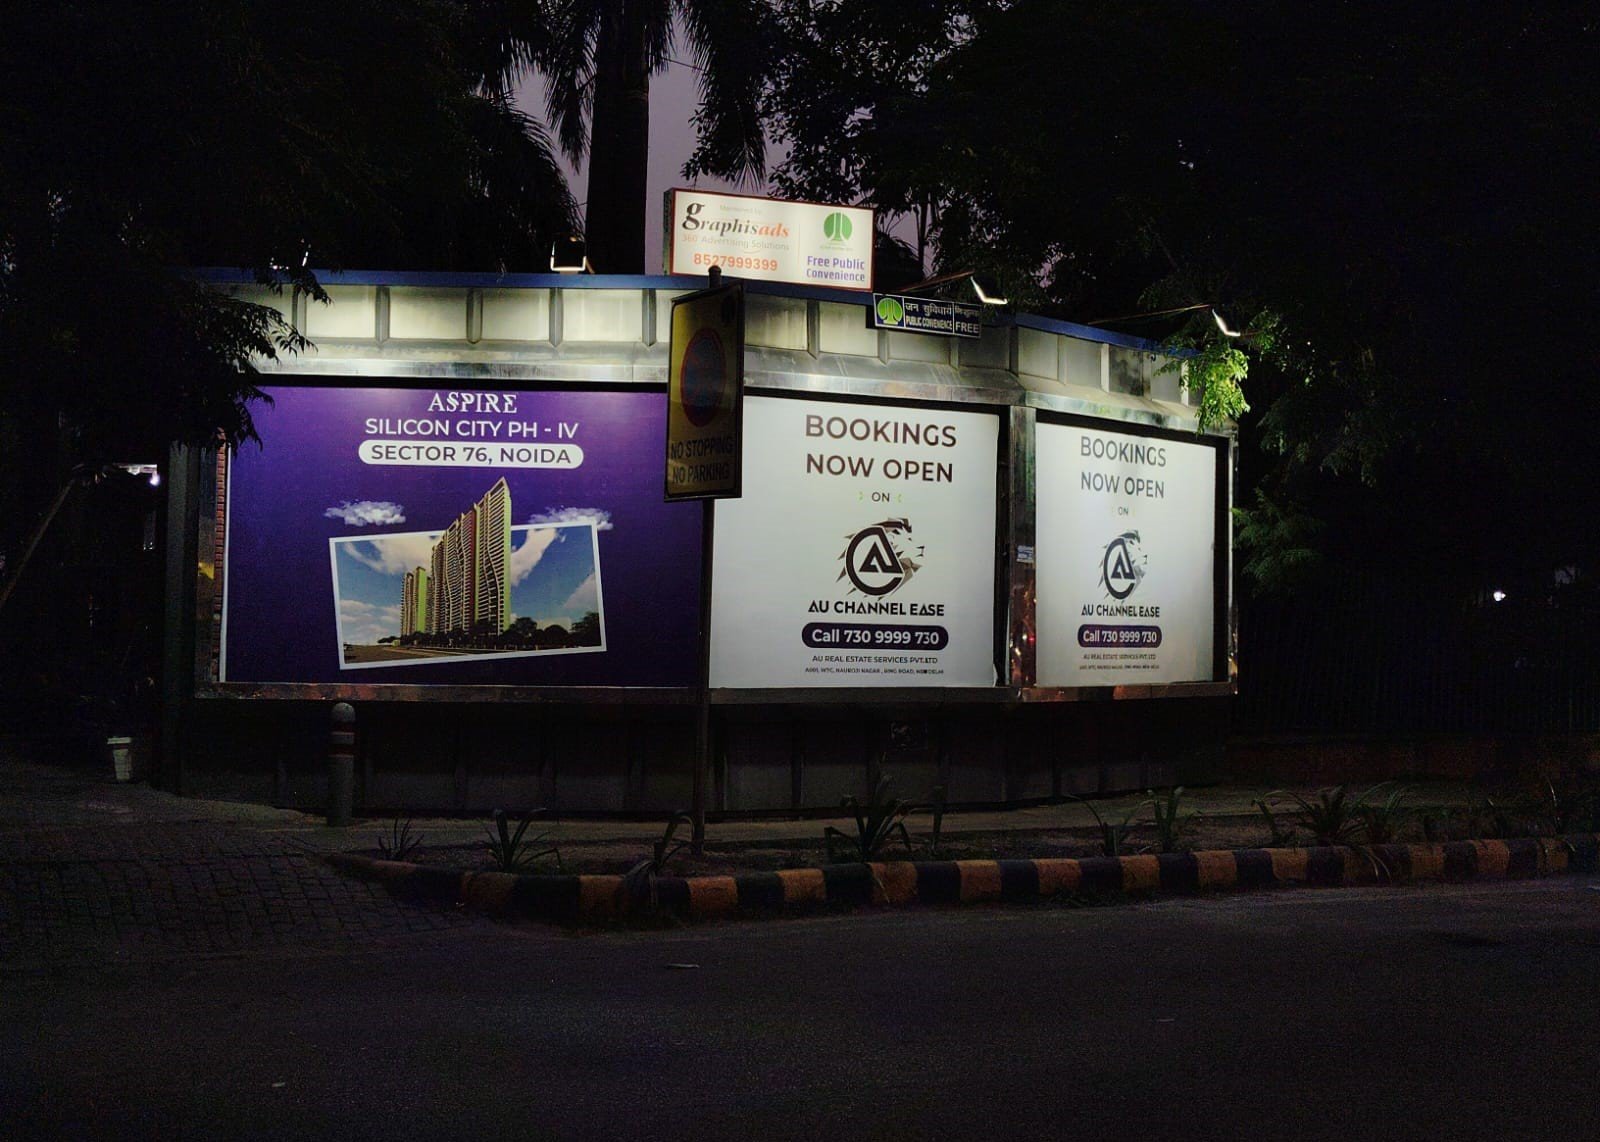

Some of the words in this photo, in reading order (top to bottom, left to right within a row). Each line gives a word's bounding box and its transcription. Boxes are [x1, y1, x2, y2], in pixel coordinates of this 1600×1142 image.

[682, 202, 789, 237] graphisads
[693, 253, 778, 272] 8527999399
[807, 255, 829, 268] Free
[832, 257, 865, 271] Public
[806, 268, 865, 282] Convenience
[905, 315, 922, 327] PUBLIC
[955, 320, 980, 334] FREE
[427, 391, 518, 414] ASPIRE
[365, 418, 450, 437] SILICON
[456, 420, 503, 438] CITY
[508, 422, 538, 439] PH
[558, 423, 579, 439] IV
[805, 414, 957, 448] BOOKINGS
[371, 444, 455, 462] SECTOR
[462, 445, 493, 465] 76,
[499, 447, 571, 465] NOIDA
[671, 441, 685, 459] NO
[686, 436, 734, 458] STOPPING
[1080, 436, 1166, 467] BOOKINGS
[672, 466, 686, 483] NO
[688, 463, 730, 483] PARKING
[806, 453, 874, 478] NOW
[883, 459, 953, 483] OPEN
[1081, 471, 1120, 495] NOW
[1124, 476, 1164, 499] OPEN
[871, 492, 890, 503] ON
[1117, 506, 1129, 516] ON
[808, 599, 829, 614] AU
[834, 600, 907, 616] CHANNEL
[910, 603, 945, 617] EASE
[1081, 604, 1094, 617] AU
[1096, 604, 1138, 618] CHANNEL
[1139, 606, 1160, 618] EASE
[812, 628, 840, 644] Call
[844, 629, 871, 644] 730
[874, 629, 911, 645] 9999
[915, 630, 940, 645] 730
[1083, 630, 1100, 643] Call
[1102, 630, 1117, 643] 730
[1119, 630, 1140, 644] 9999
[1141, 631, 1157, 644] 730
[825, 655, 844, 663] REAL
[873, 656, 908, 664] SERVICES
